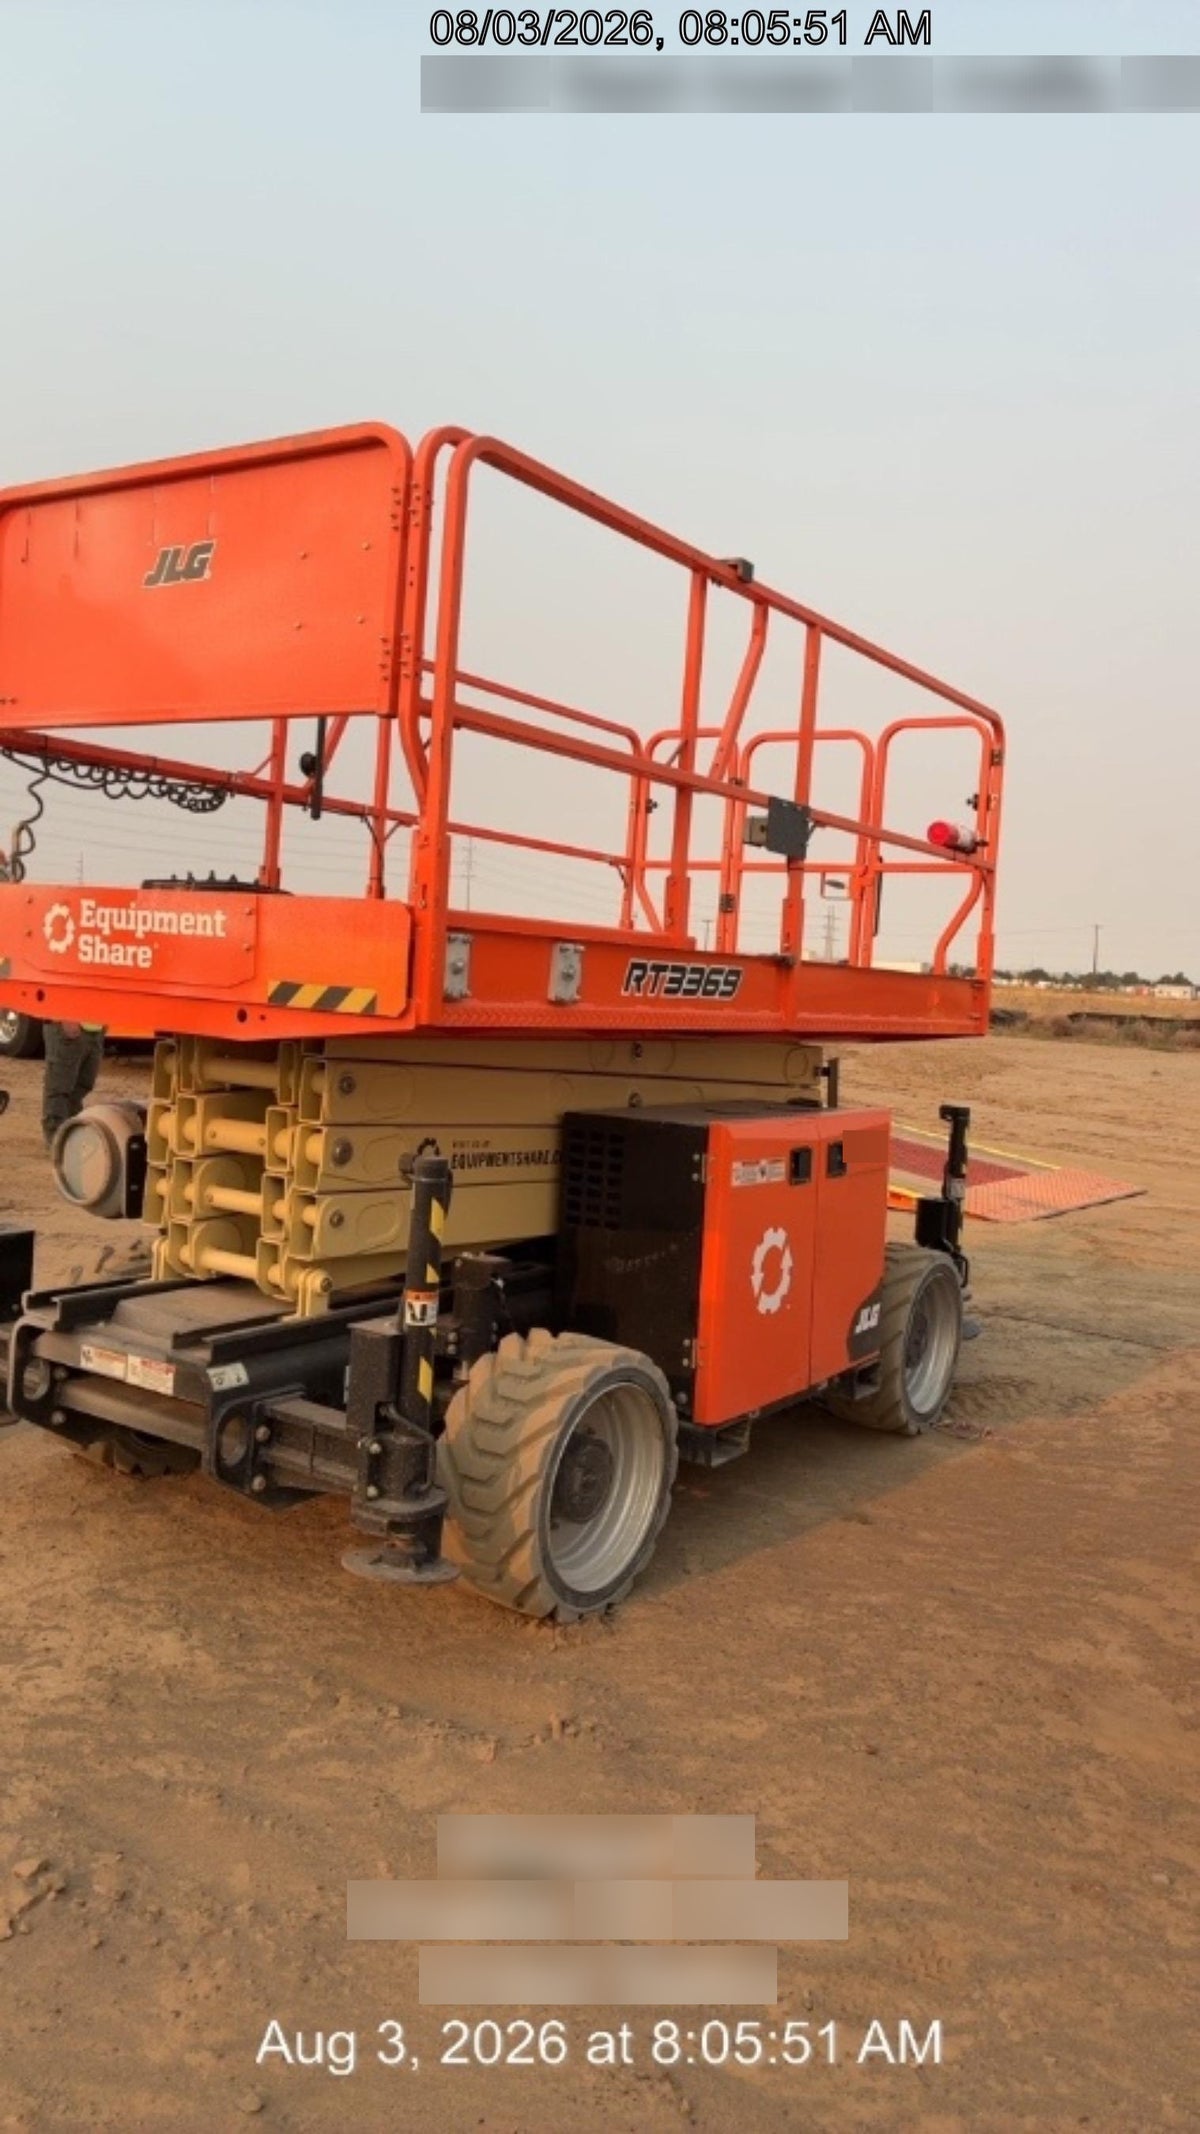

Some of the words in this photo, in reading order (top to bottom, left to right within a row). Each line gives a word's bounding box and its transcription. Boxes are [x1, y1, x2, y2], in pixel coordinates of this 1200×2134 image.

[142, 540, 215, 588] JLG
[80, 899, 226, 939] Equipment
[78, 934, 153, 968] Share
[621, 959, 744, 1000] RT3369
[855, 1303, 881, 1334] JLG
